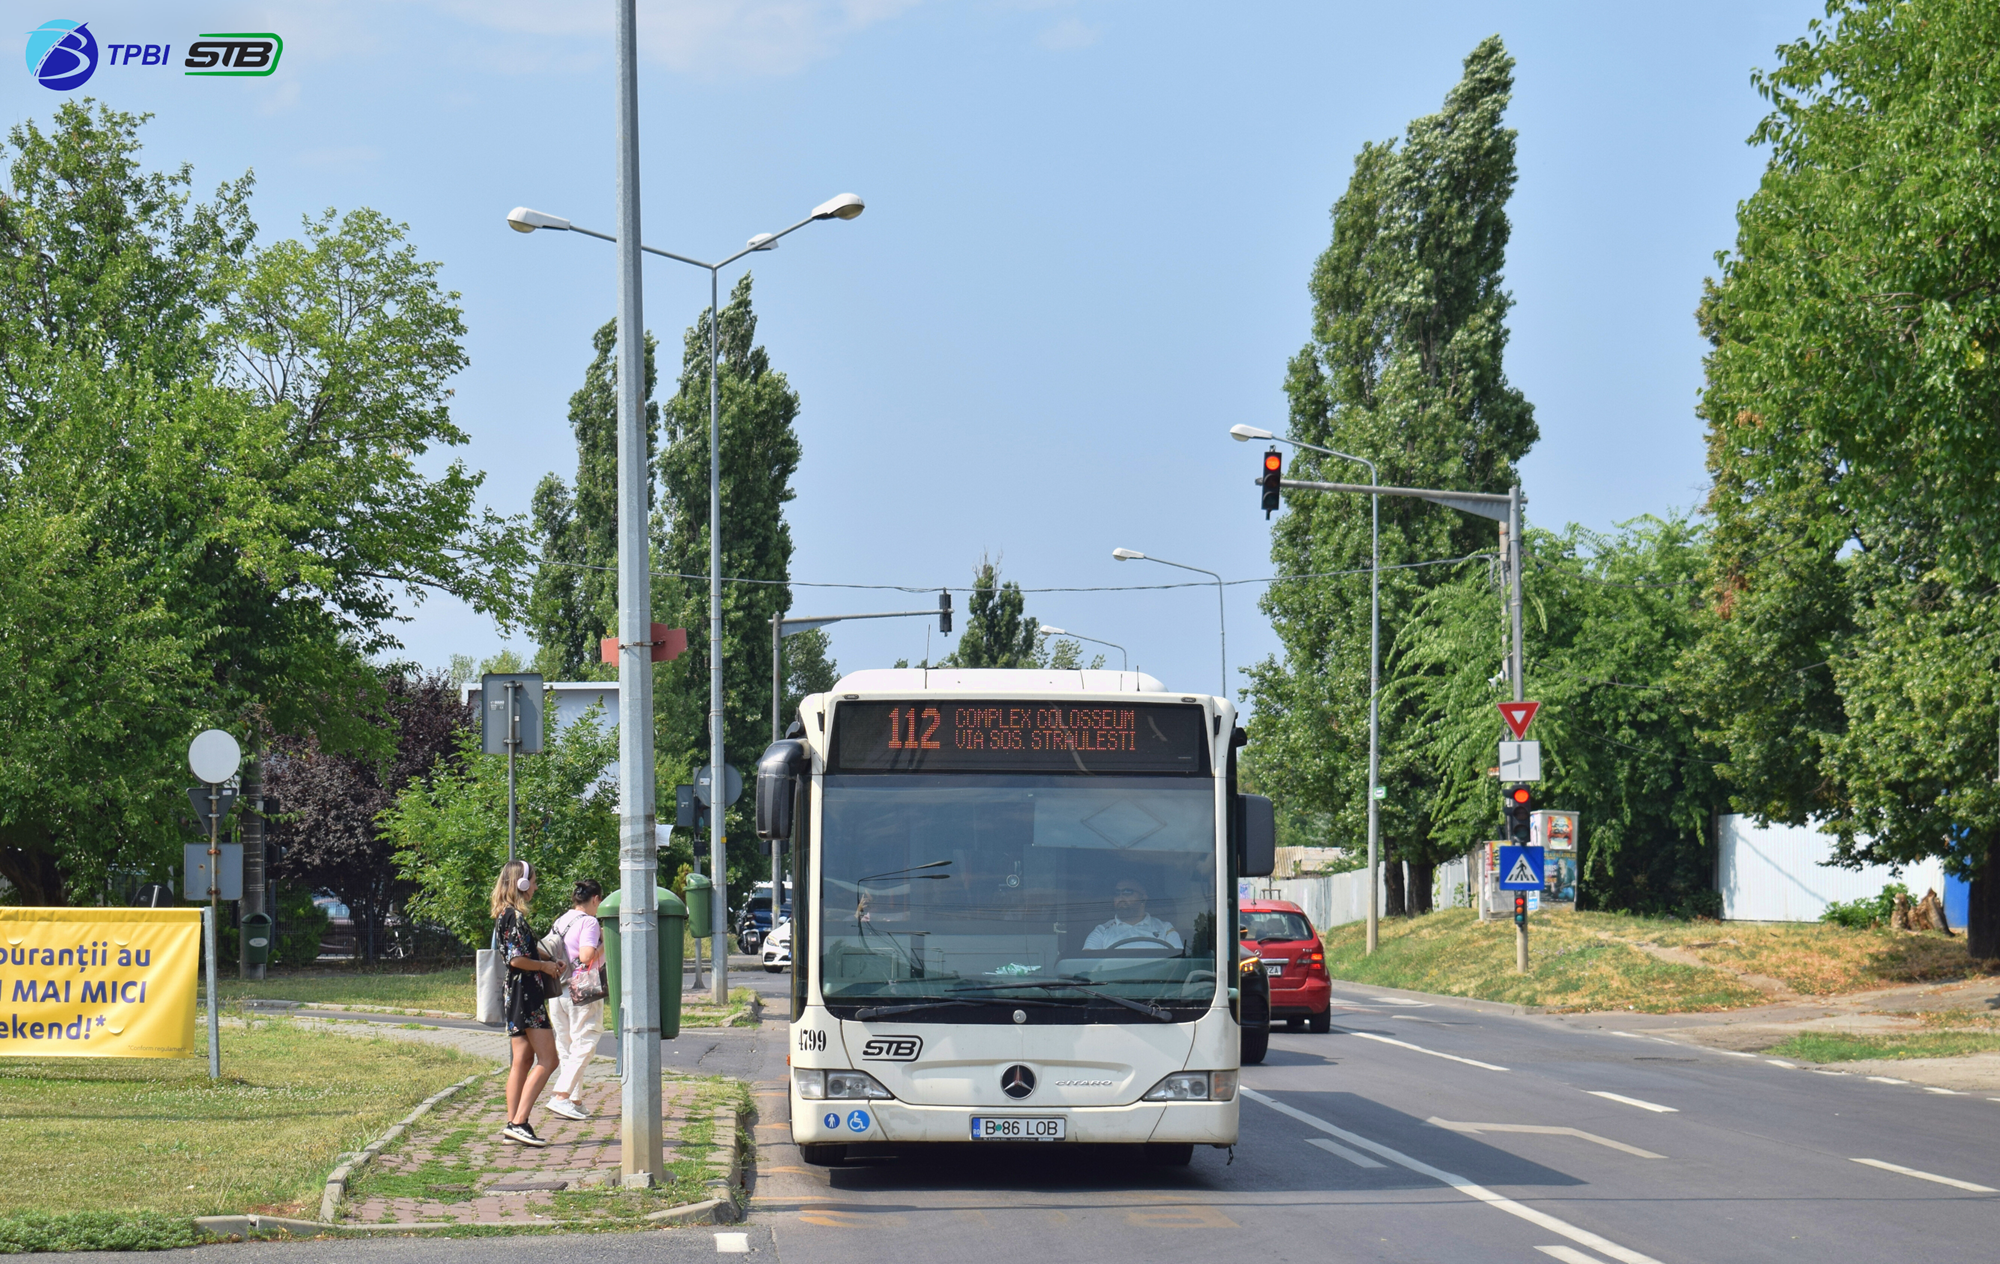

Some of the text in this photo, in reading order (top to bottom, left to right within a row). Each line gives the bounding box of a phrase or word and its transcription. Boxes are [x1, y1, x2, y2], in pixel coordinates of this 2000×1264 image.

[888, 708, 941, 749] 112
[955, 708, 1135, 729] COMPLEX COLOSSEUM
[955, 730, 1136, 750] VIA SOS. STRAULESTI
[117, 949, 151, 967] au
[12, 980, 71, 1003] MAI
[80, 981, 147, 1004] MICI
[798, 1029, 827, 1052] 4799
[862, 1039, 917, 1056] STB
[1055, 1079, 1113, 1087] CITARO
[985, 1120, 1058, 1135] B 86 LOB
